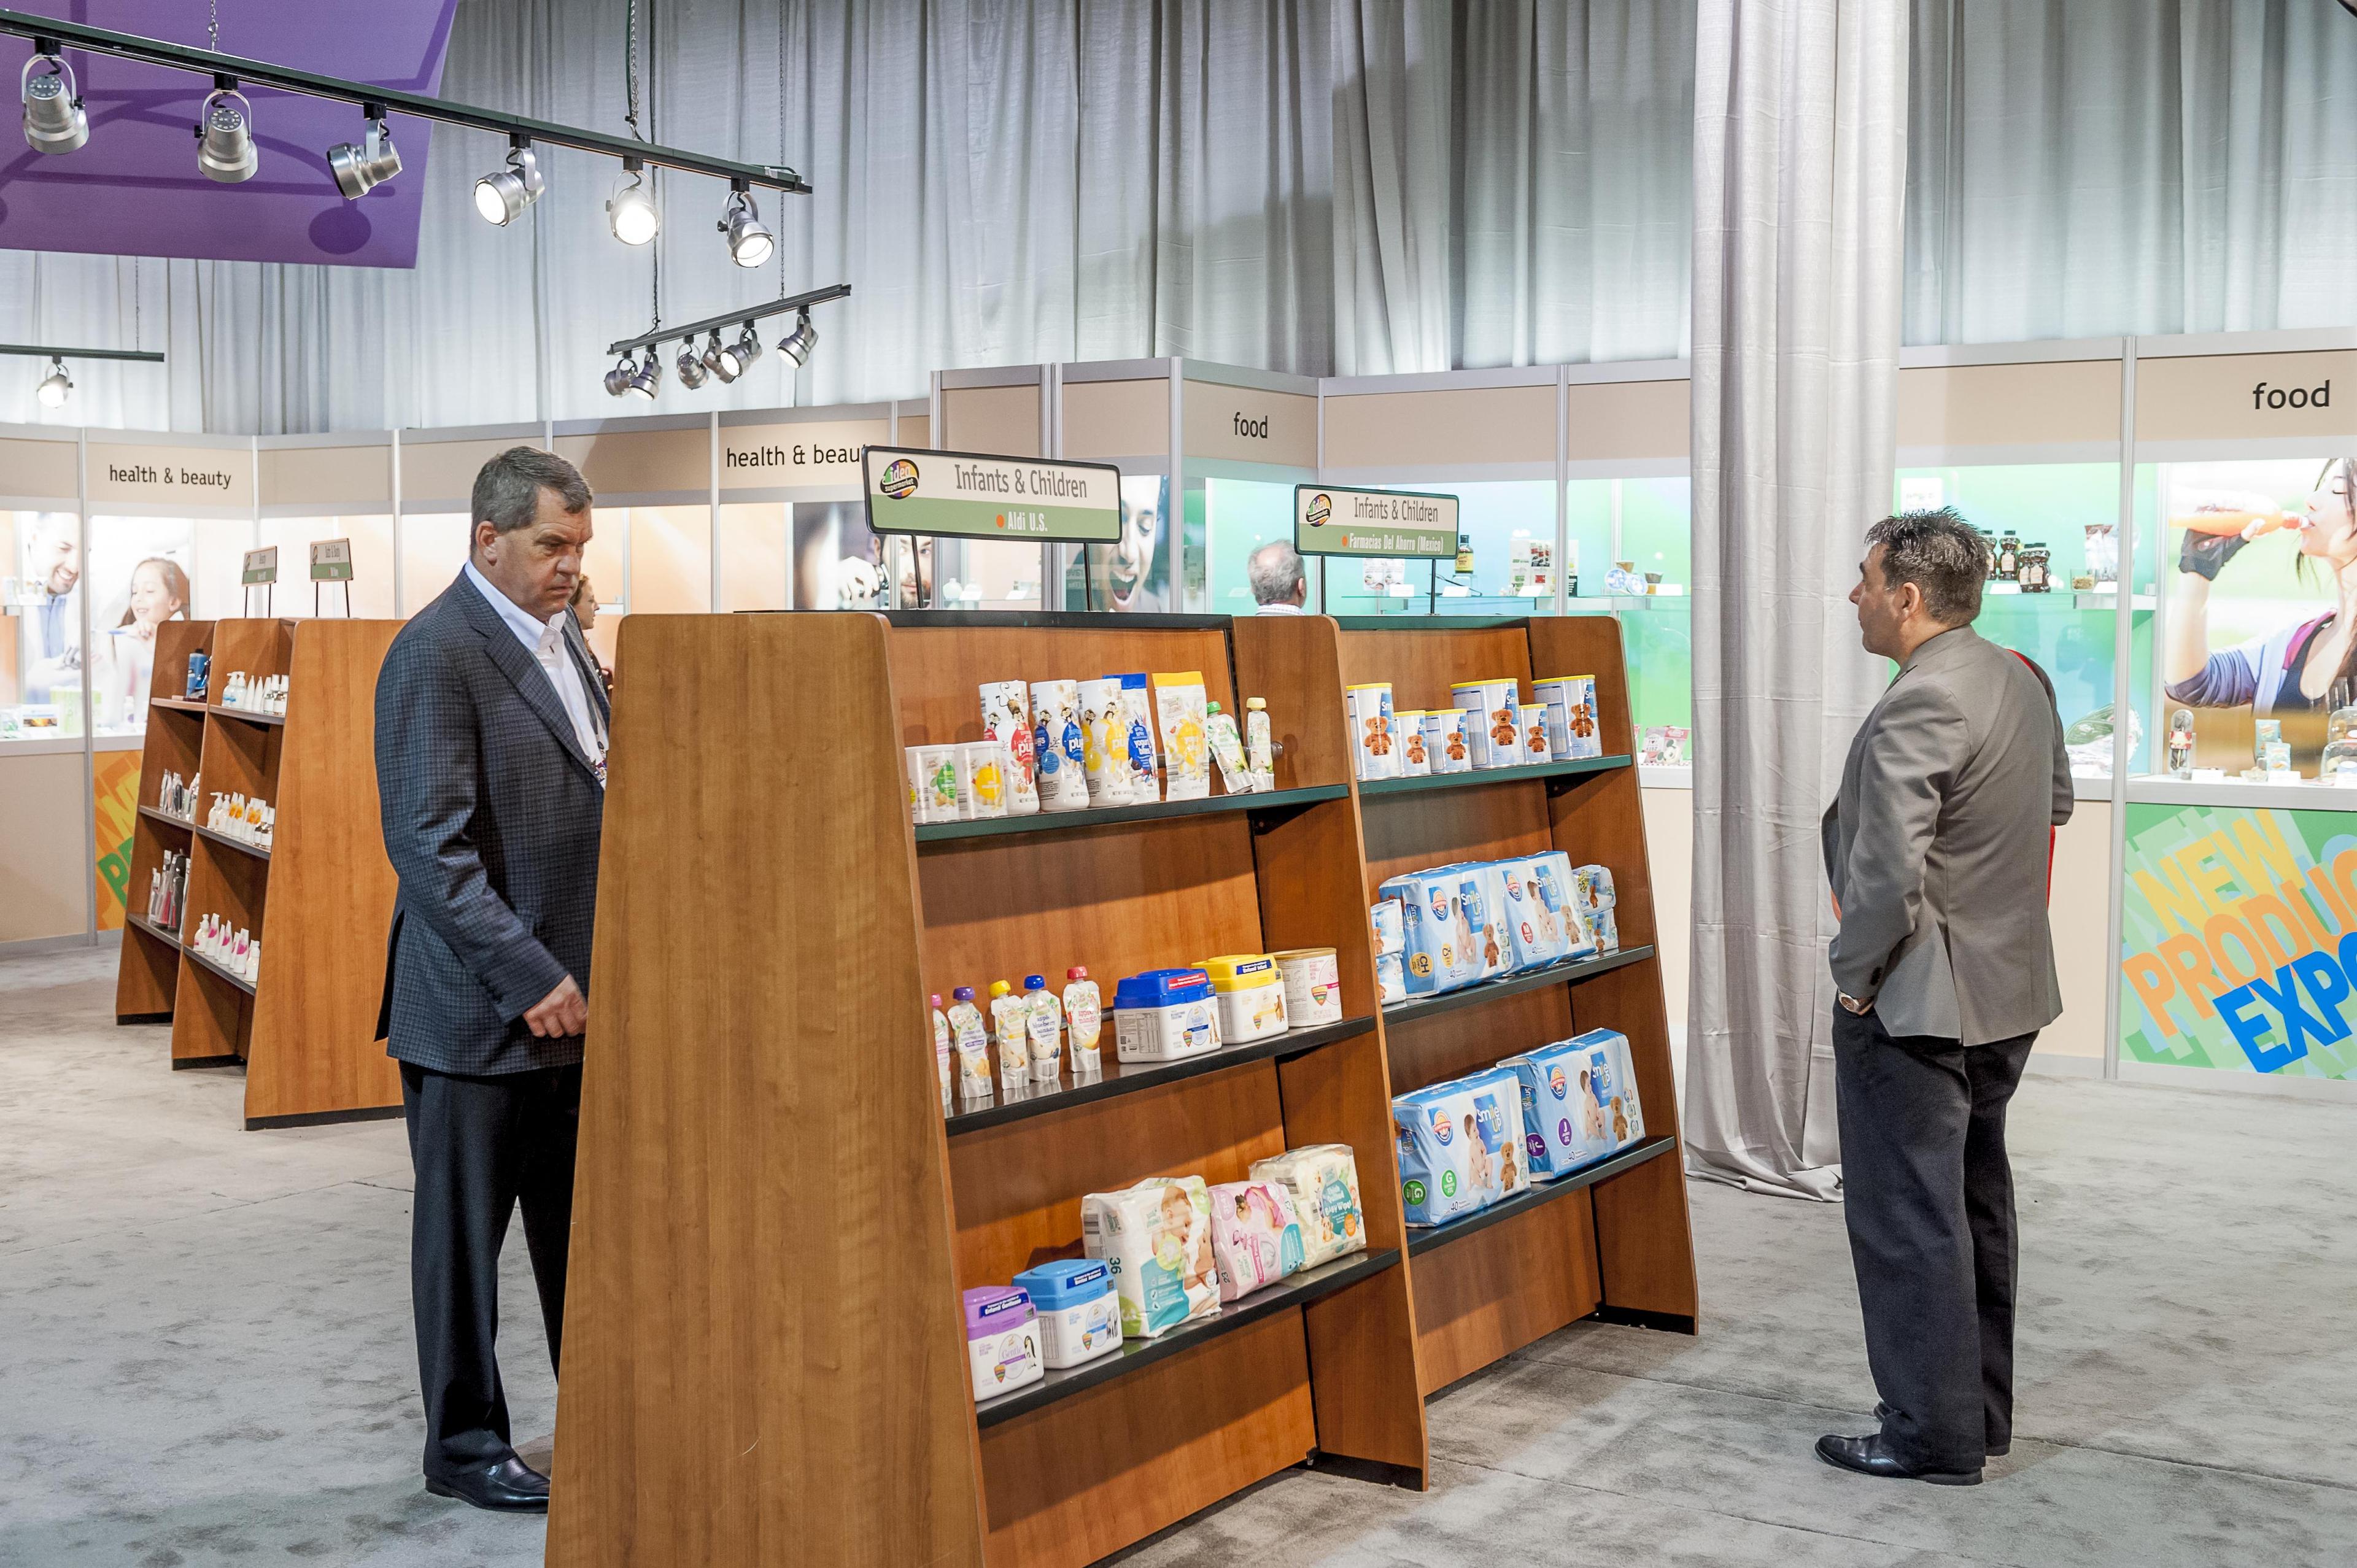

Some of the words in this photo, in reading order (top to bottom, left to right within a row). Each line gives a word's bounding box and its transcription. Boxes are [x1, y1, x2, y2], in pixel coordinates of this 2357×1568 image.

[2252, 379, 2331, 411] food
[1233, 412, 1269, 439] food
[726, 445, 785, 468] health
[792, 445, 807, 465] &
[813, 443, 862, 465] beau
[109, 465, 158, 484] health
[163, 467, 174, 484] &
[180, 468, 232, 490] beauty
[889, 465, 911, 483] idea
[955, 463, 1010, 495] Infants
[1014, 468, 1027, 495] &
[1029, 469, 1088, 498] Children
[1354, 497, 1388, 520] Infants
[1391, 500, 1399, 520] &
[1401, 500, 1439, 523] Children
[1007, 511, 1026, 531] Aldi
[1029, 512, 1048, 533] U.S.
[1349, 533, 1382, 550] Farmacias
[1384, 535, 1394, 549] Del
[1396, 536, 1415, 551] Ahorro
[1417, 535, 1444, 555] (Mexico)
[2132, 808, 2307, 938] NEW
[1419, 955, 1430, 973] CH
[1477, 1103, 1500, 1124] Smile
[1492, 1118, 1502, 1133] UP
[1450, 1201, 1459, 1211] 40
[1109, 1256, 1122, 1275] 36
[1001, 1346, 1023, 1359] Gentle
